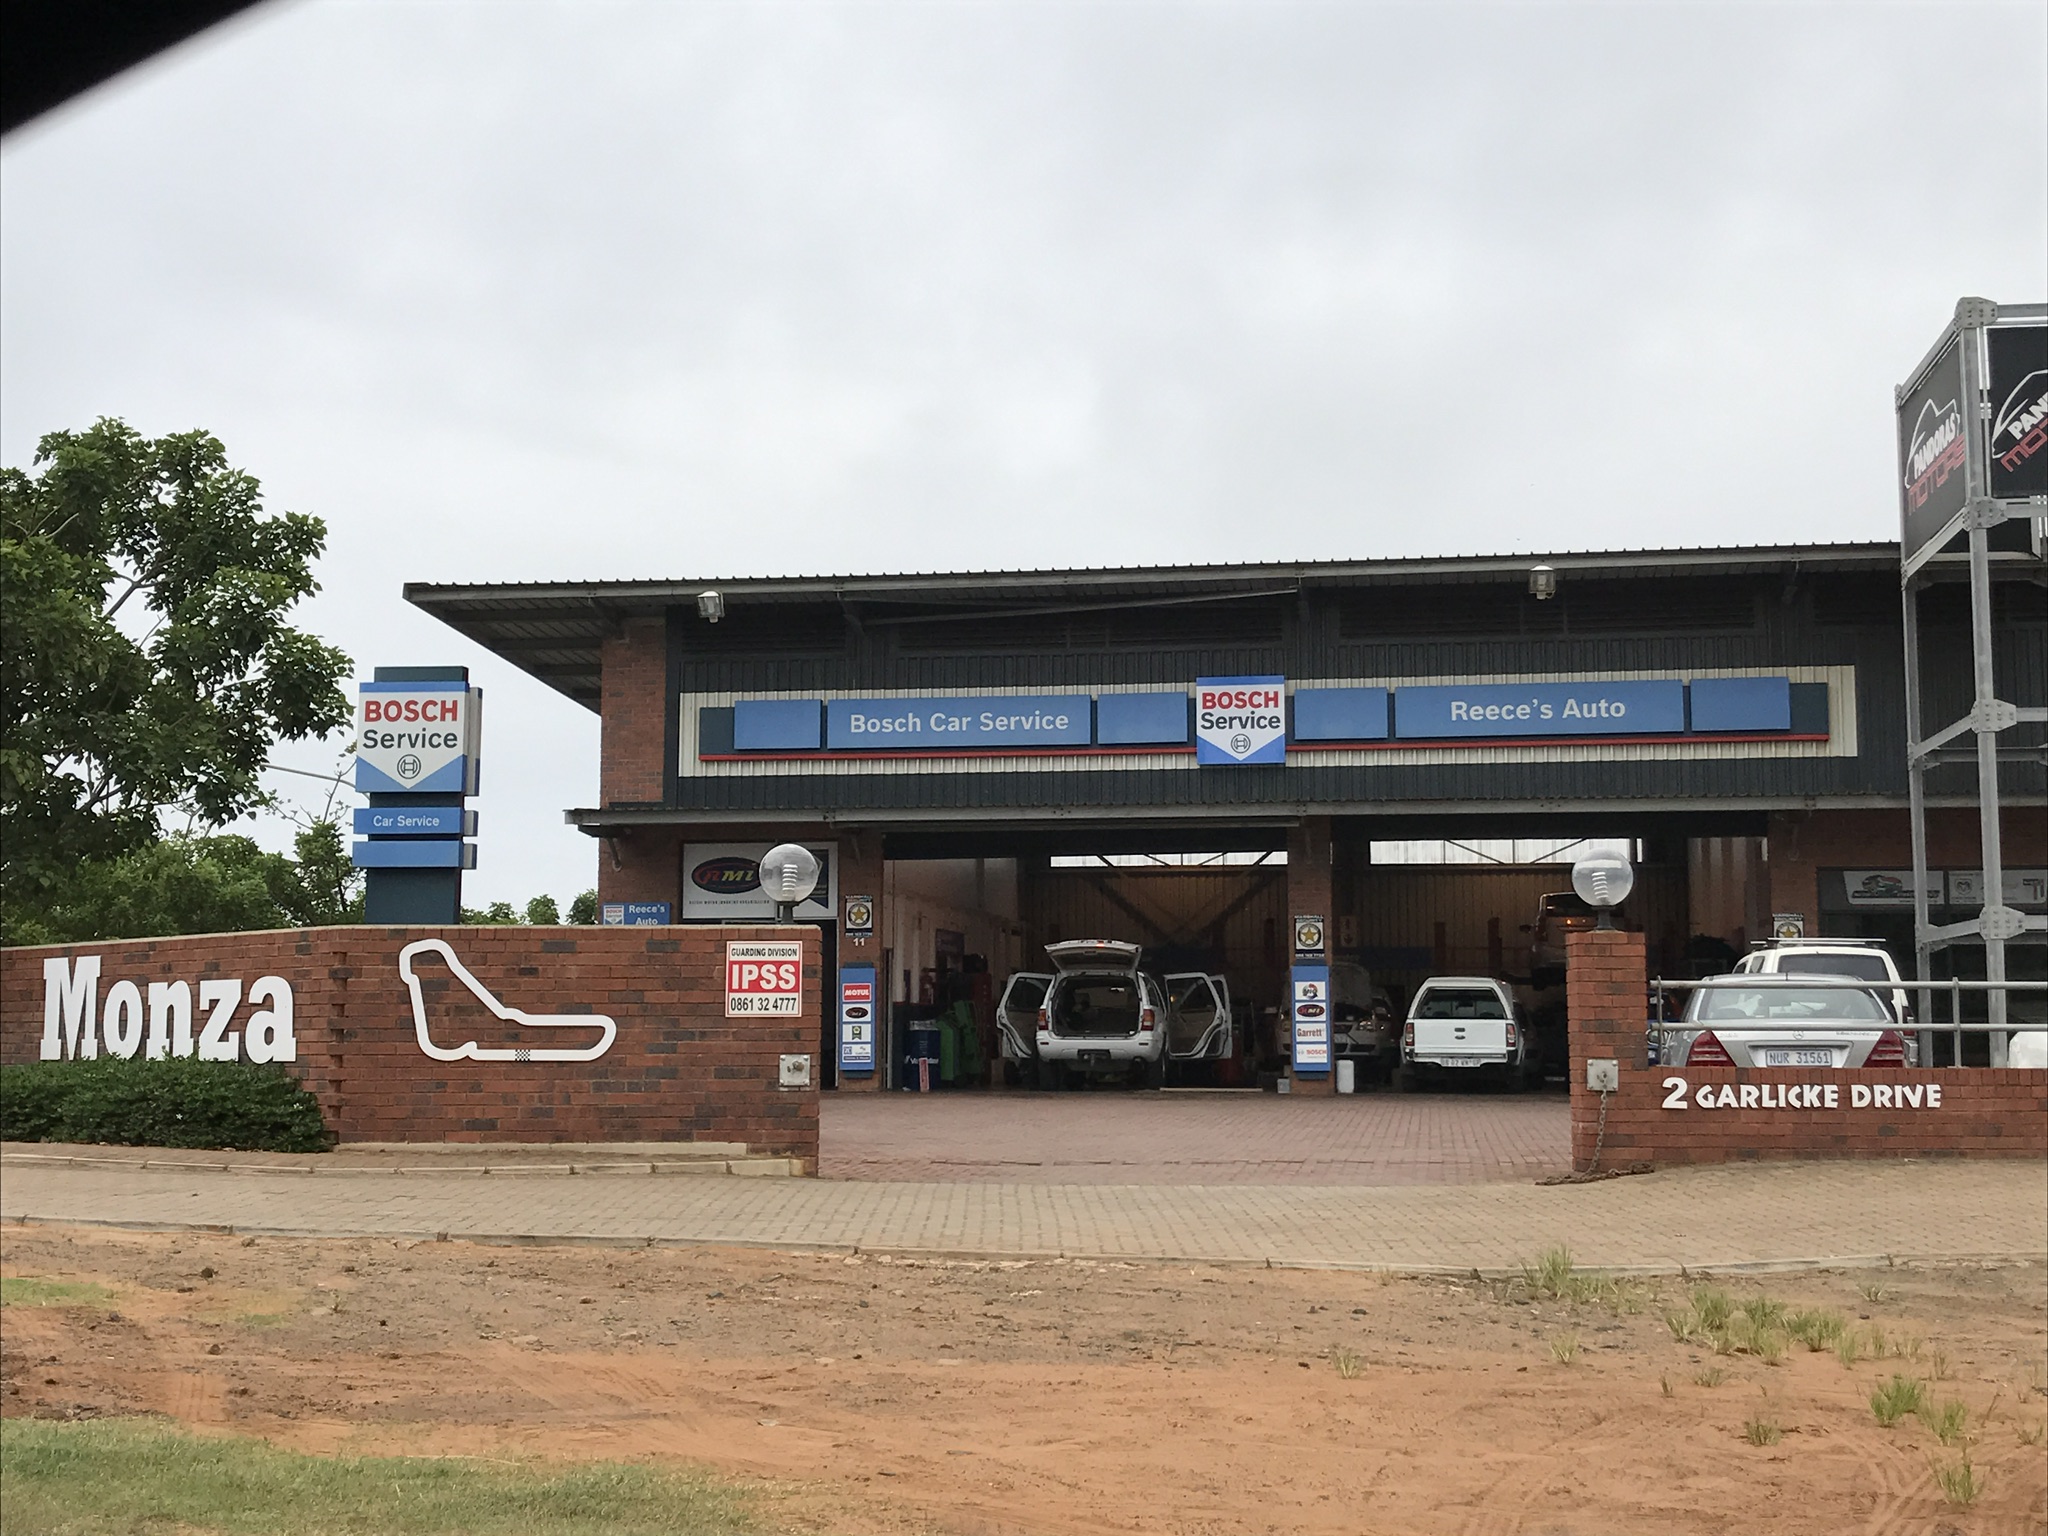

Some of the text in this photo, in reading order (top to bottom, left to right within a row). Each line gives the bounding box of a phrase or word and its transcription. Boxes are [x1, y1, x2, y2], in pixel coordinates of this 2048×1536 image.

[1914, 413, 1956, 480] PANDORAS
[1202, 691, 1279, 710] BOSCH
[1562, 698, 1626, 719] Auto
[364, 700, 458, 722] BOSCH
[1200, 710, 1281, 730] Service
[850, 710, 1069, 733] Bosch Car Service
[362, 727, 458, 750] Service
[373, 815, 440, 827] Car Service
[629, 903, 665, 913] Reece's
[636, 917, 658, 925] Auto
[853, 938, 864, 946] 11
[731, 948, 797, 957] GUARDING DIVISION
[732, 964, 796, 990] IPSS
[40, 955, 297, 1064] Monza
[730, 997, 797, 1011] 0861 32 4777
[1297, 1028, 1322, 1037] Garrett
[1769, 1053, 1830, 1064] NUR 31561
[1661, 1077, 1942, 1109] 2 GARLICKE DRIVE
